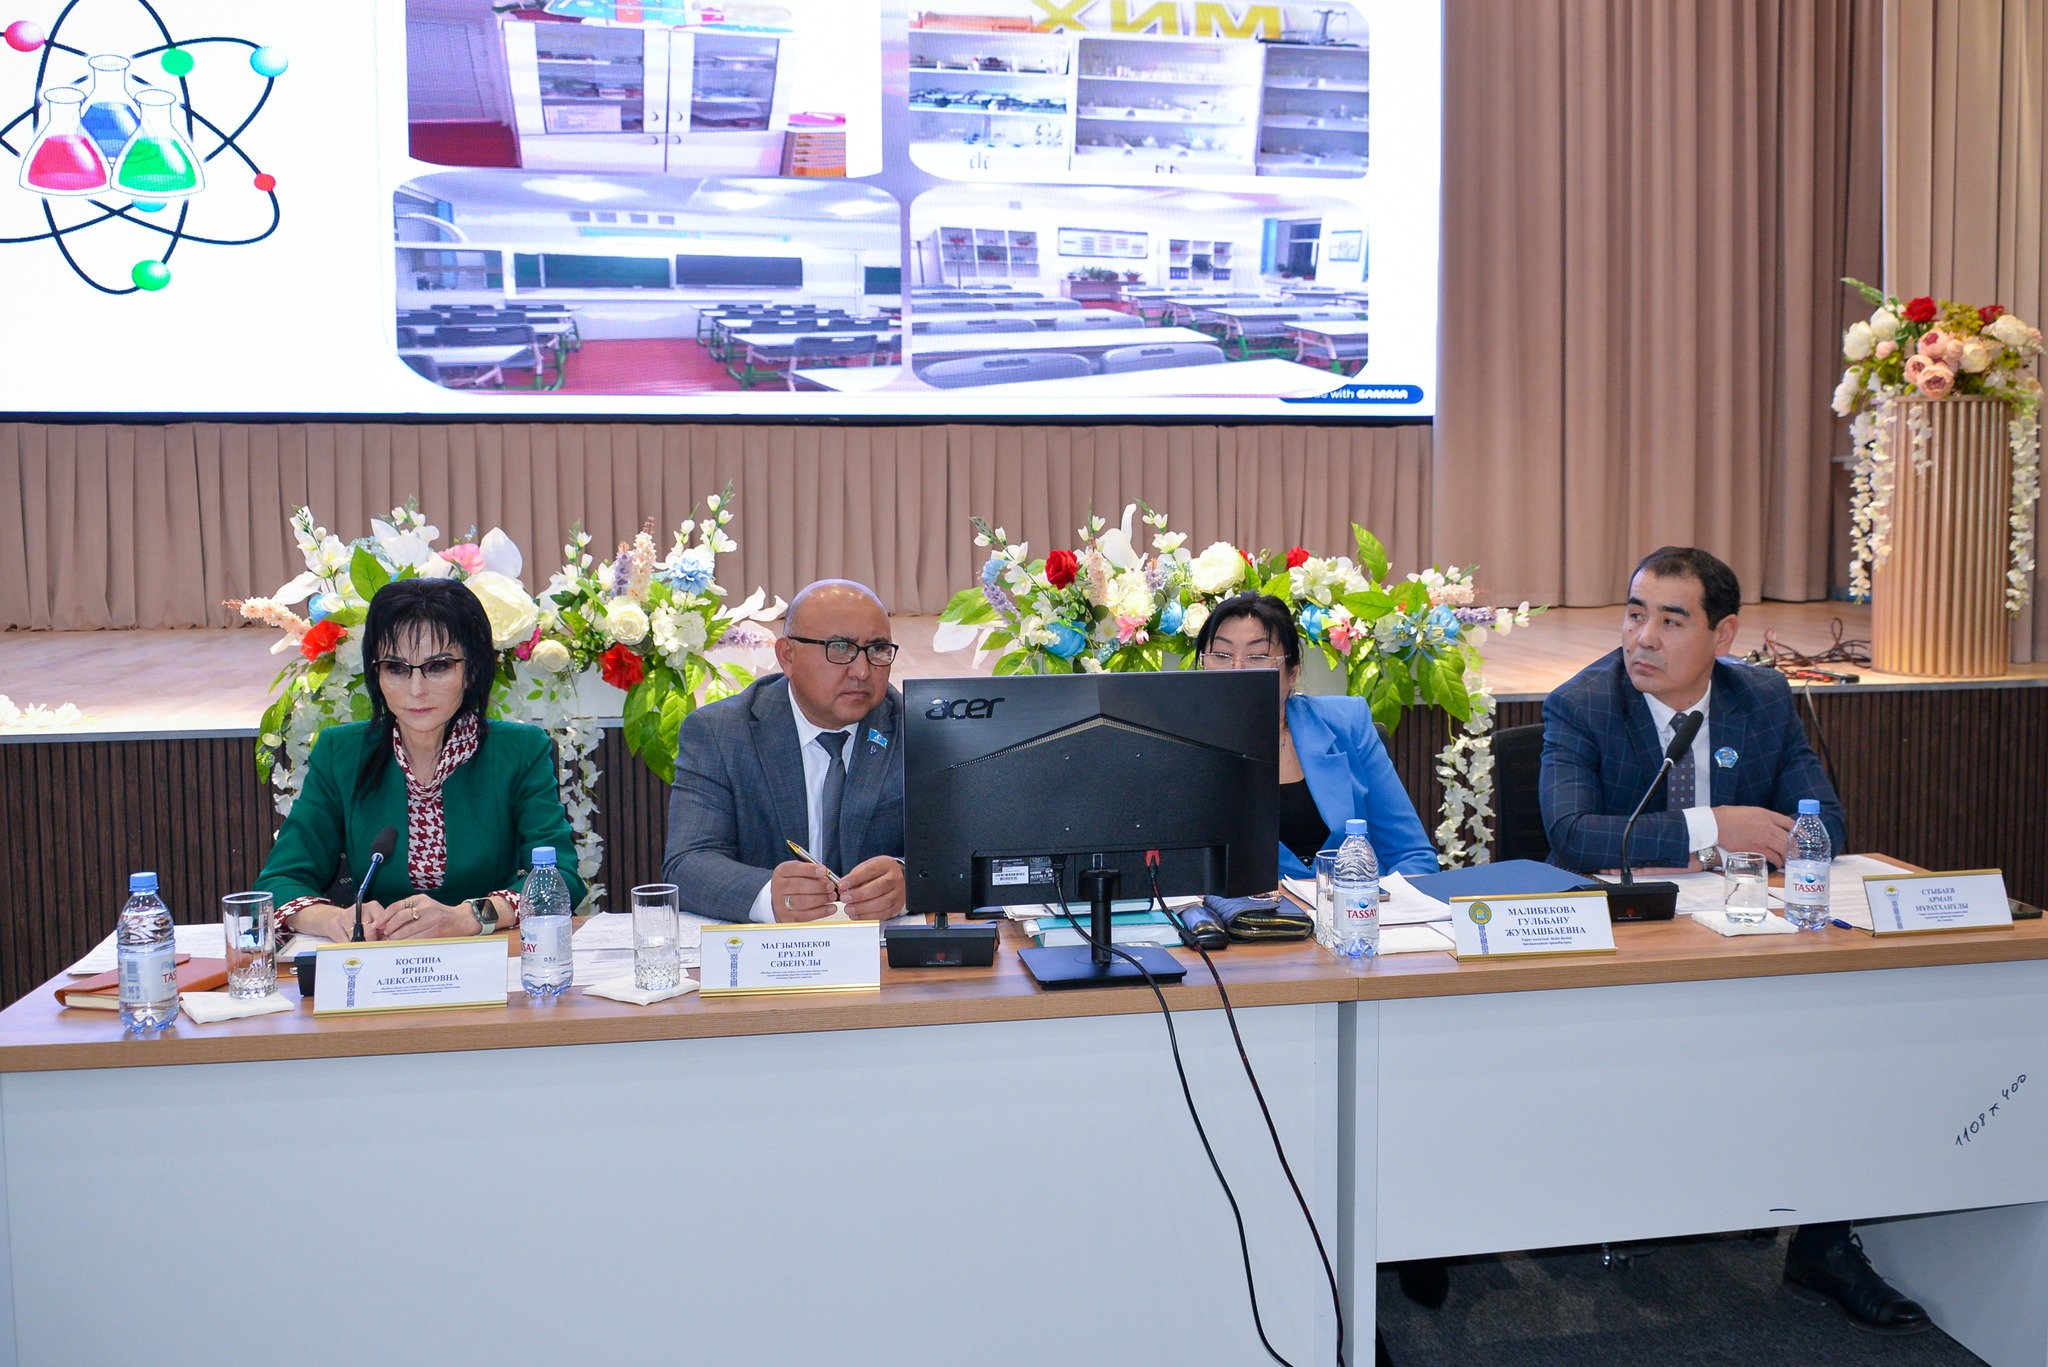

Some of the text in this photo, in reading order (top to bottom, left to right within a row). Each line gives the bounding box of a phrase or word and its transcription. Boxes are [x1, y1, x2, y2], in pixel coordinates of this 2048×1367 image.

[1330, 389, 1354, 399] with
[1356, 389, 1408, 399] GAMMA
[925, 698, 1005, 720] acer
[1793, 883, 1825, 893] TASSAY
[1921, 887, 1956, 896] СТЫБАЕВ
[1928, 895, 1953, 903] АРМАН
[1346, 909, 1378, 918] TASSAY
[1508, 906, 1576, 916] МАЛИБЕКОВА
[1517, 916, 1570, 926] ГУЛЬБАНУ
[1505, 926, 1586, 937] ЖУМАШБАЕВНА
[395, 956, 441, 966] КОСТИНА
[401, 966, 434, 975] ИРИНА
[376, 974, 459, 986] АЛЕКСАНДРОВНА
[1955, 1112, 1986, 1146] 1108
[2001, 1074, 2027, 1100] 400
